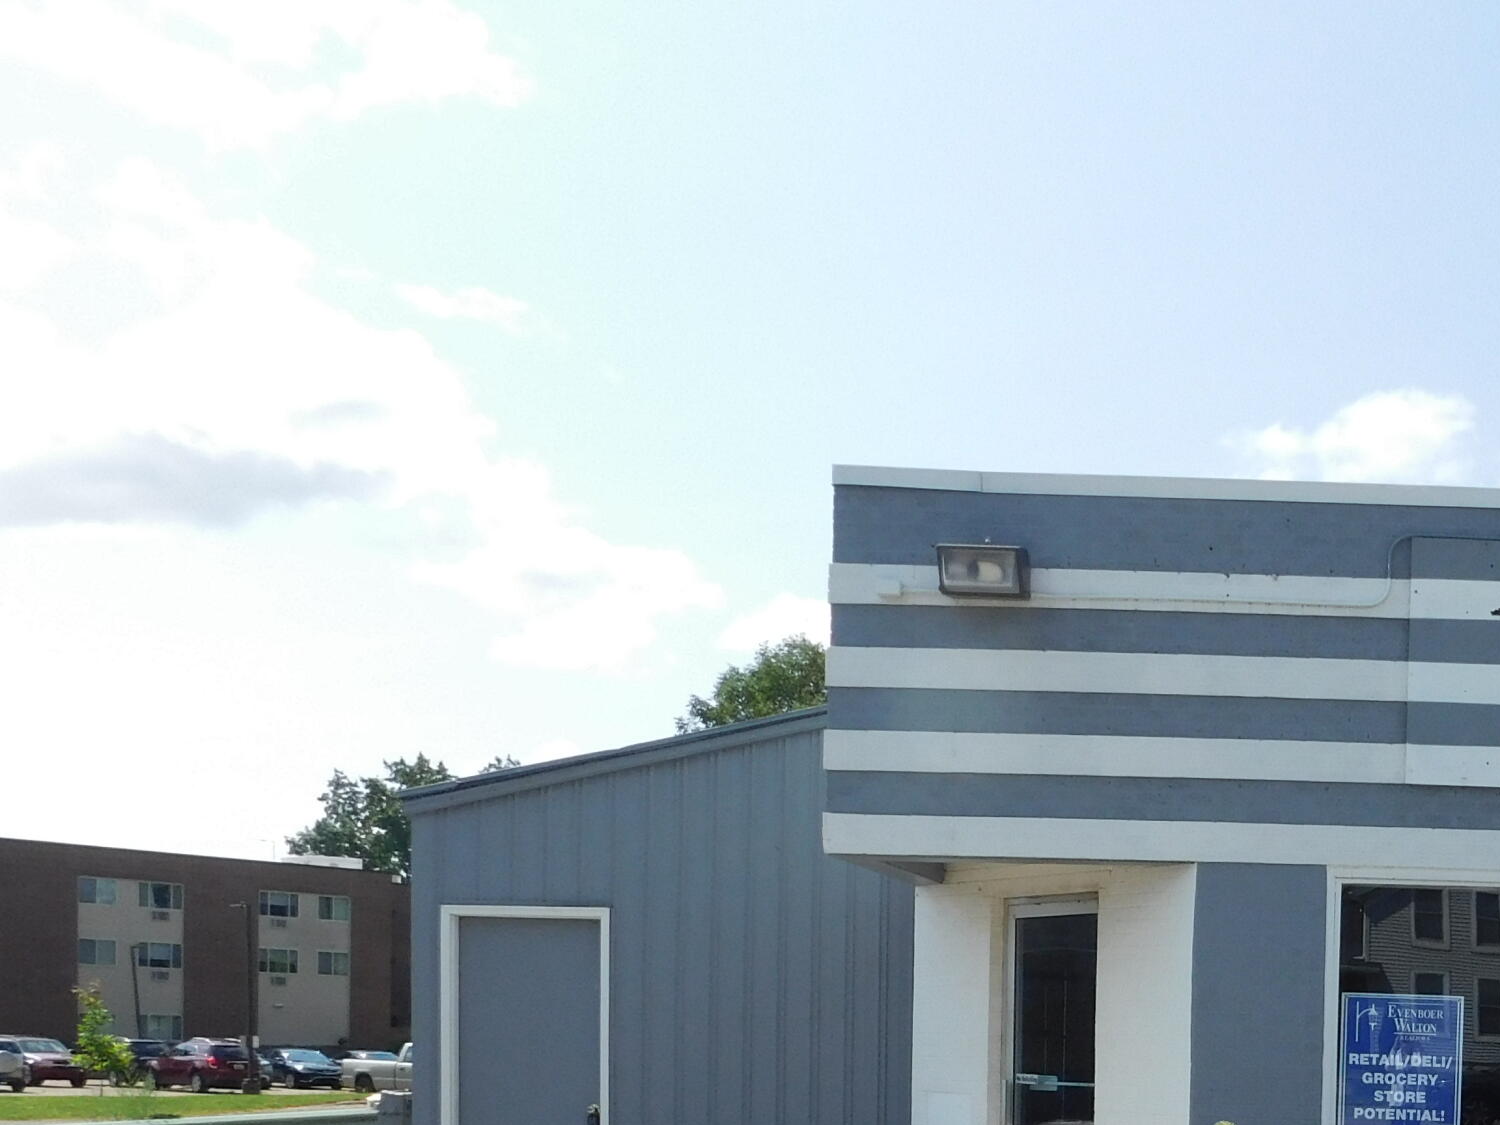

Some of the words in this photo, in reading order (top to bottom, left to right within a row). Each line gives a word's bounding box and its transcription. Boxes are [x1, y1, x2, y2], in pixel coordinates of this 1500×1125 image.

[1387, 1004, 1444, 1019] EVENBOER
[1394, 1018, 1437, 1032] WALTON
[1348, 1053, 1453, 1069] RETAIL/DELI/
[1361, 1072, 1439, 1086] GROCERY
[1373, 1090, 1427, 1104] STORE
[1353, 1107, 1445, 1122] POTENTIAL!
